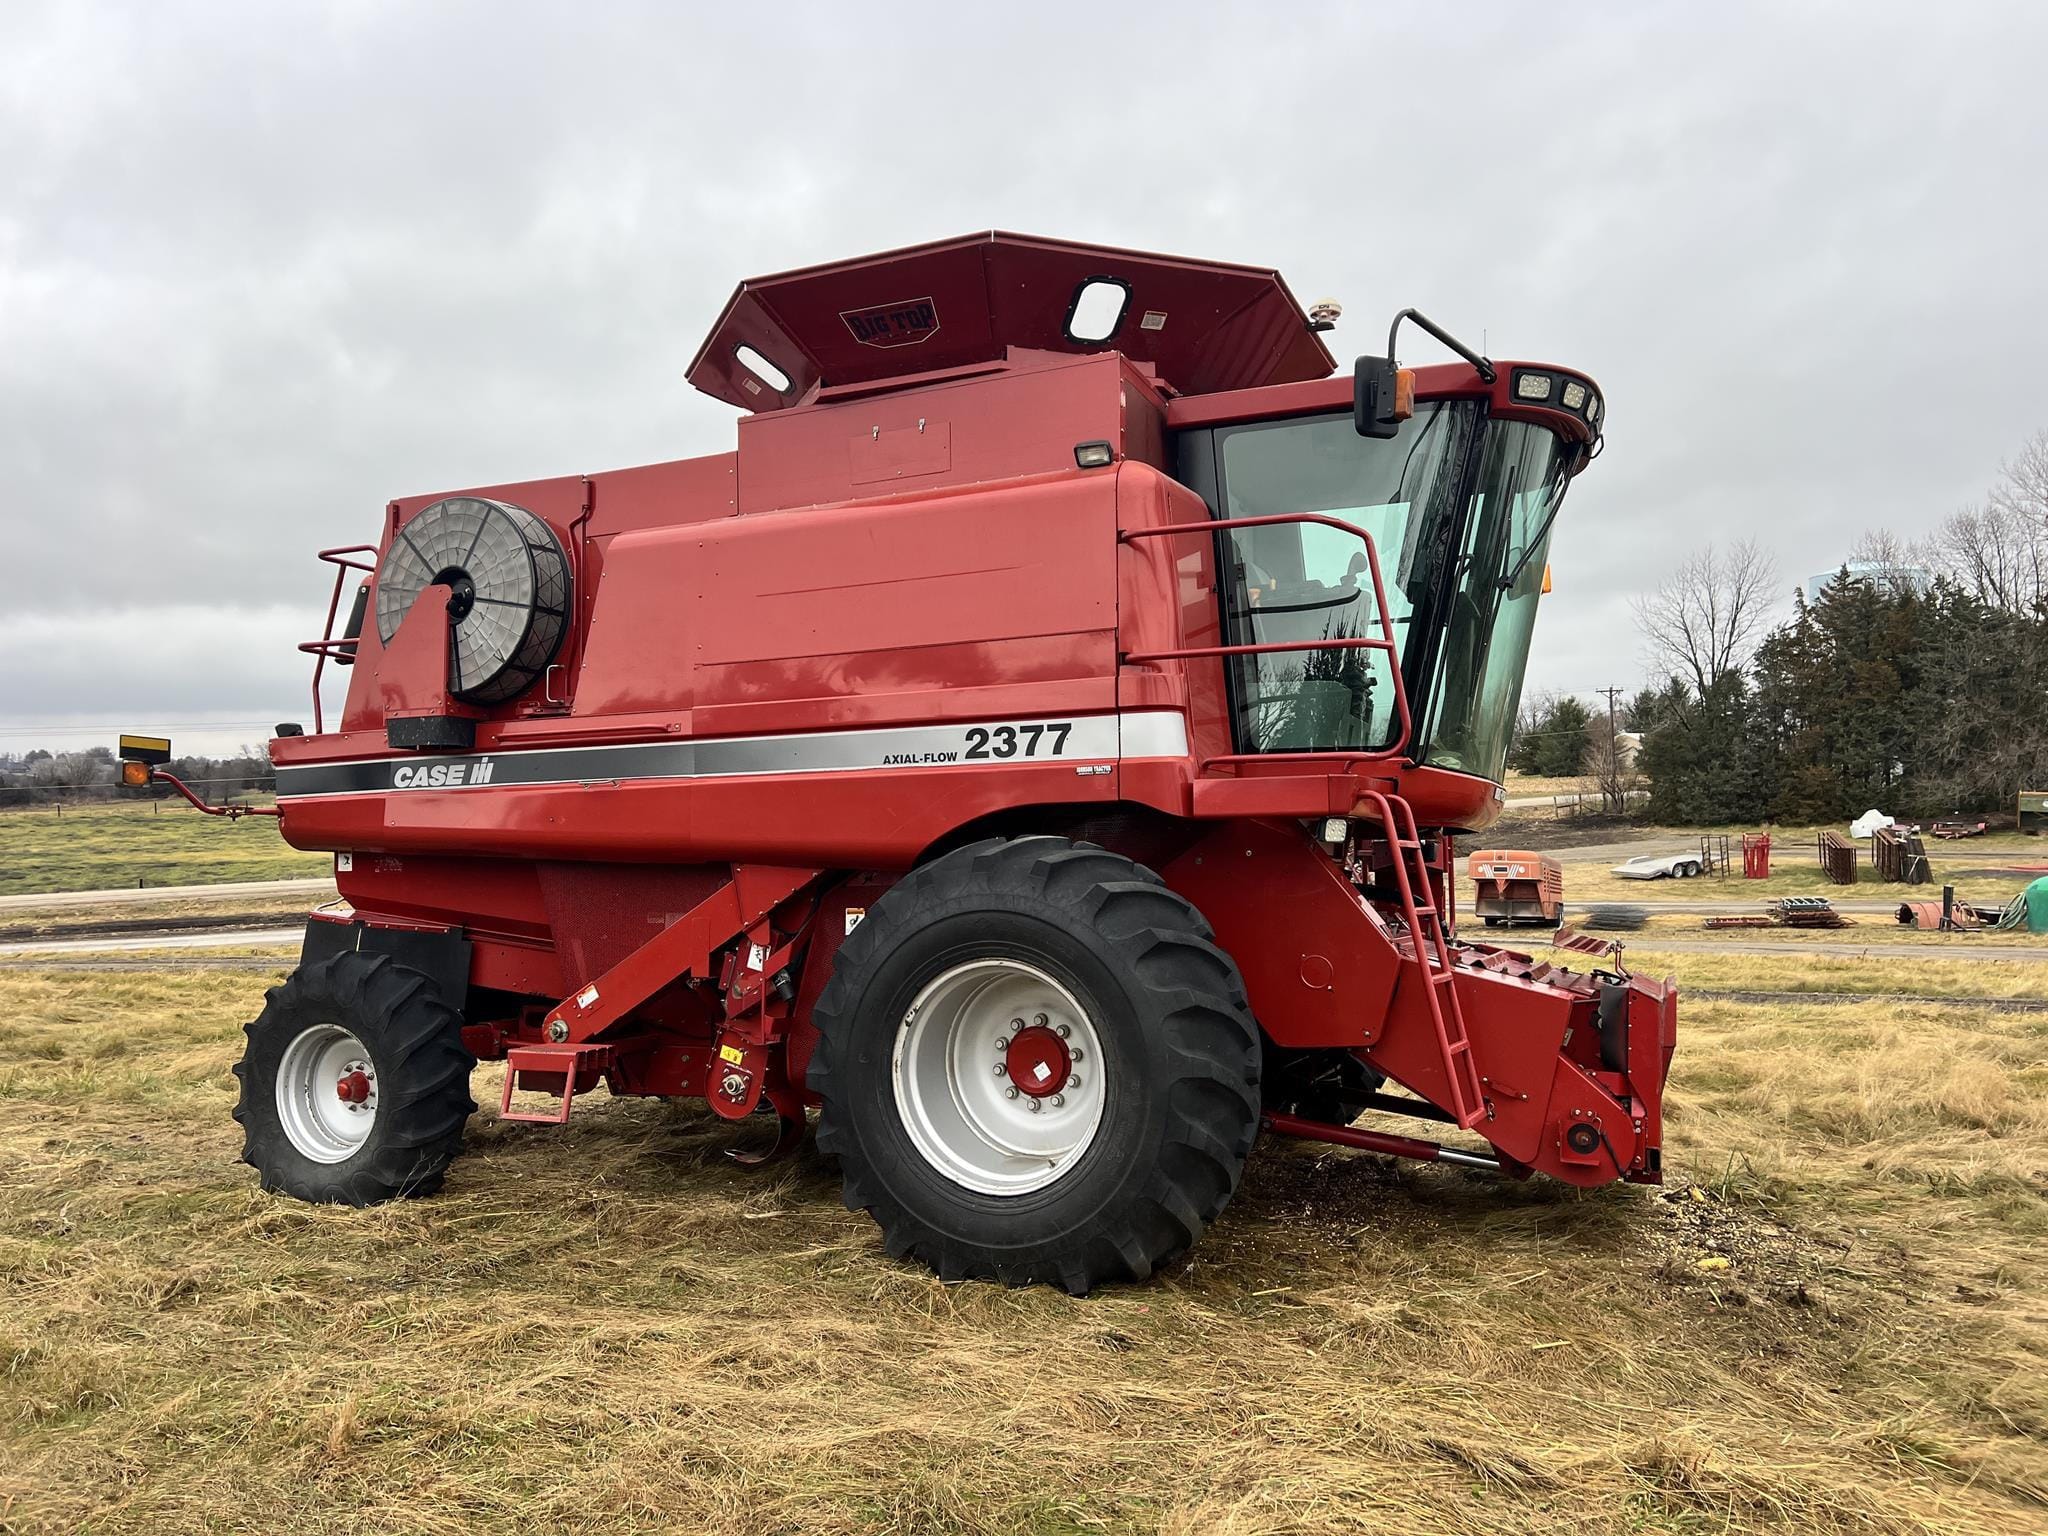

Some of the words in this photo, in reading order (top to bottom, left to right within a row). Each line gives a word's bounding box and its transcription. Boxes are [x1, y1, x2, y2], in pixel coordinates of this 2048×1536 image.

[848, 315, 890, 341] BIG
[891, 304, 932, 330] TOP
[883, 752, 958, 765] AXIAL-FLOW
[965, 723, 1072, 760] 2377
[394, 765, 466, 788] CASE
